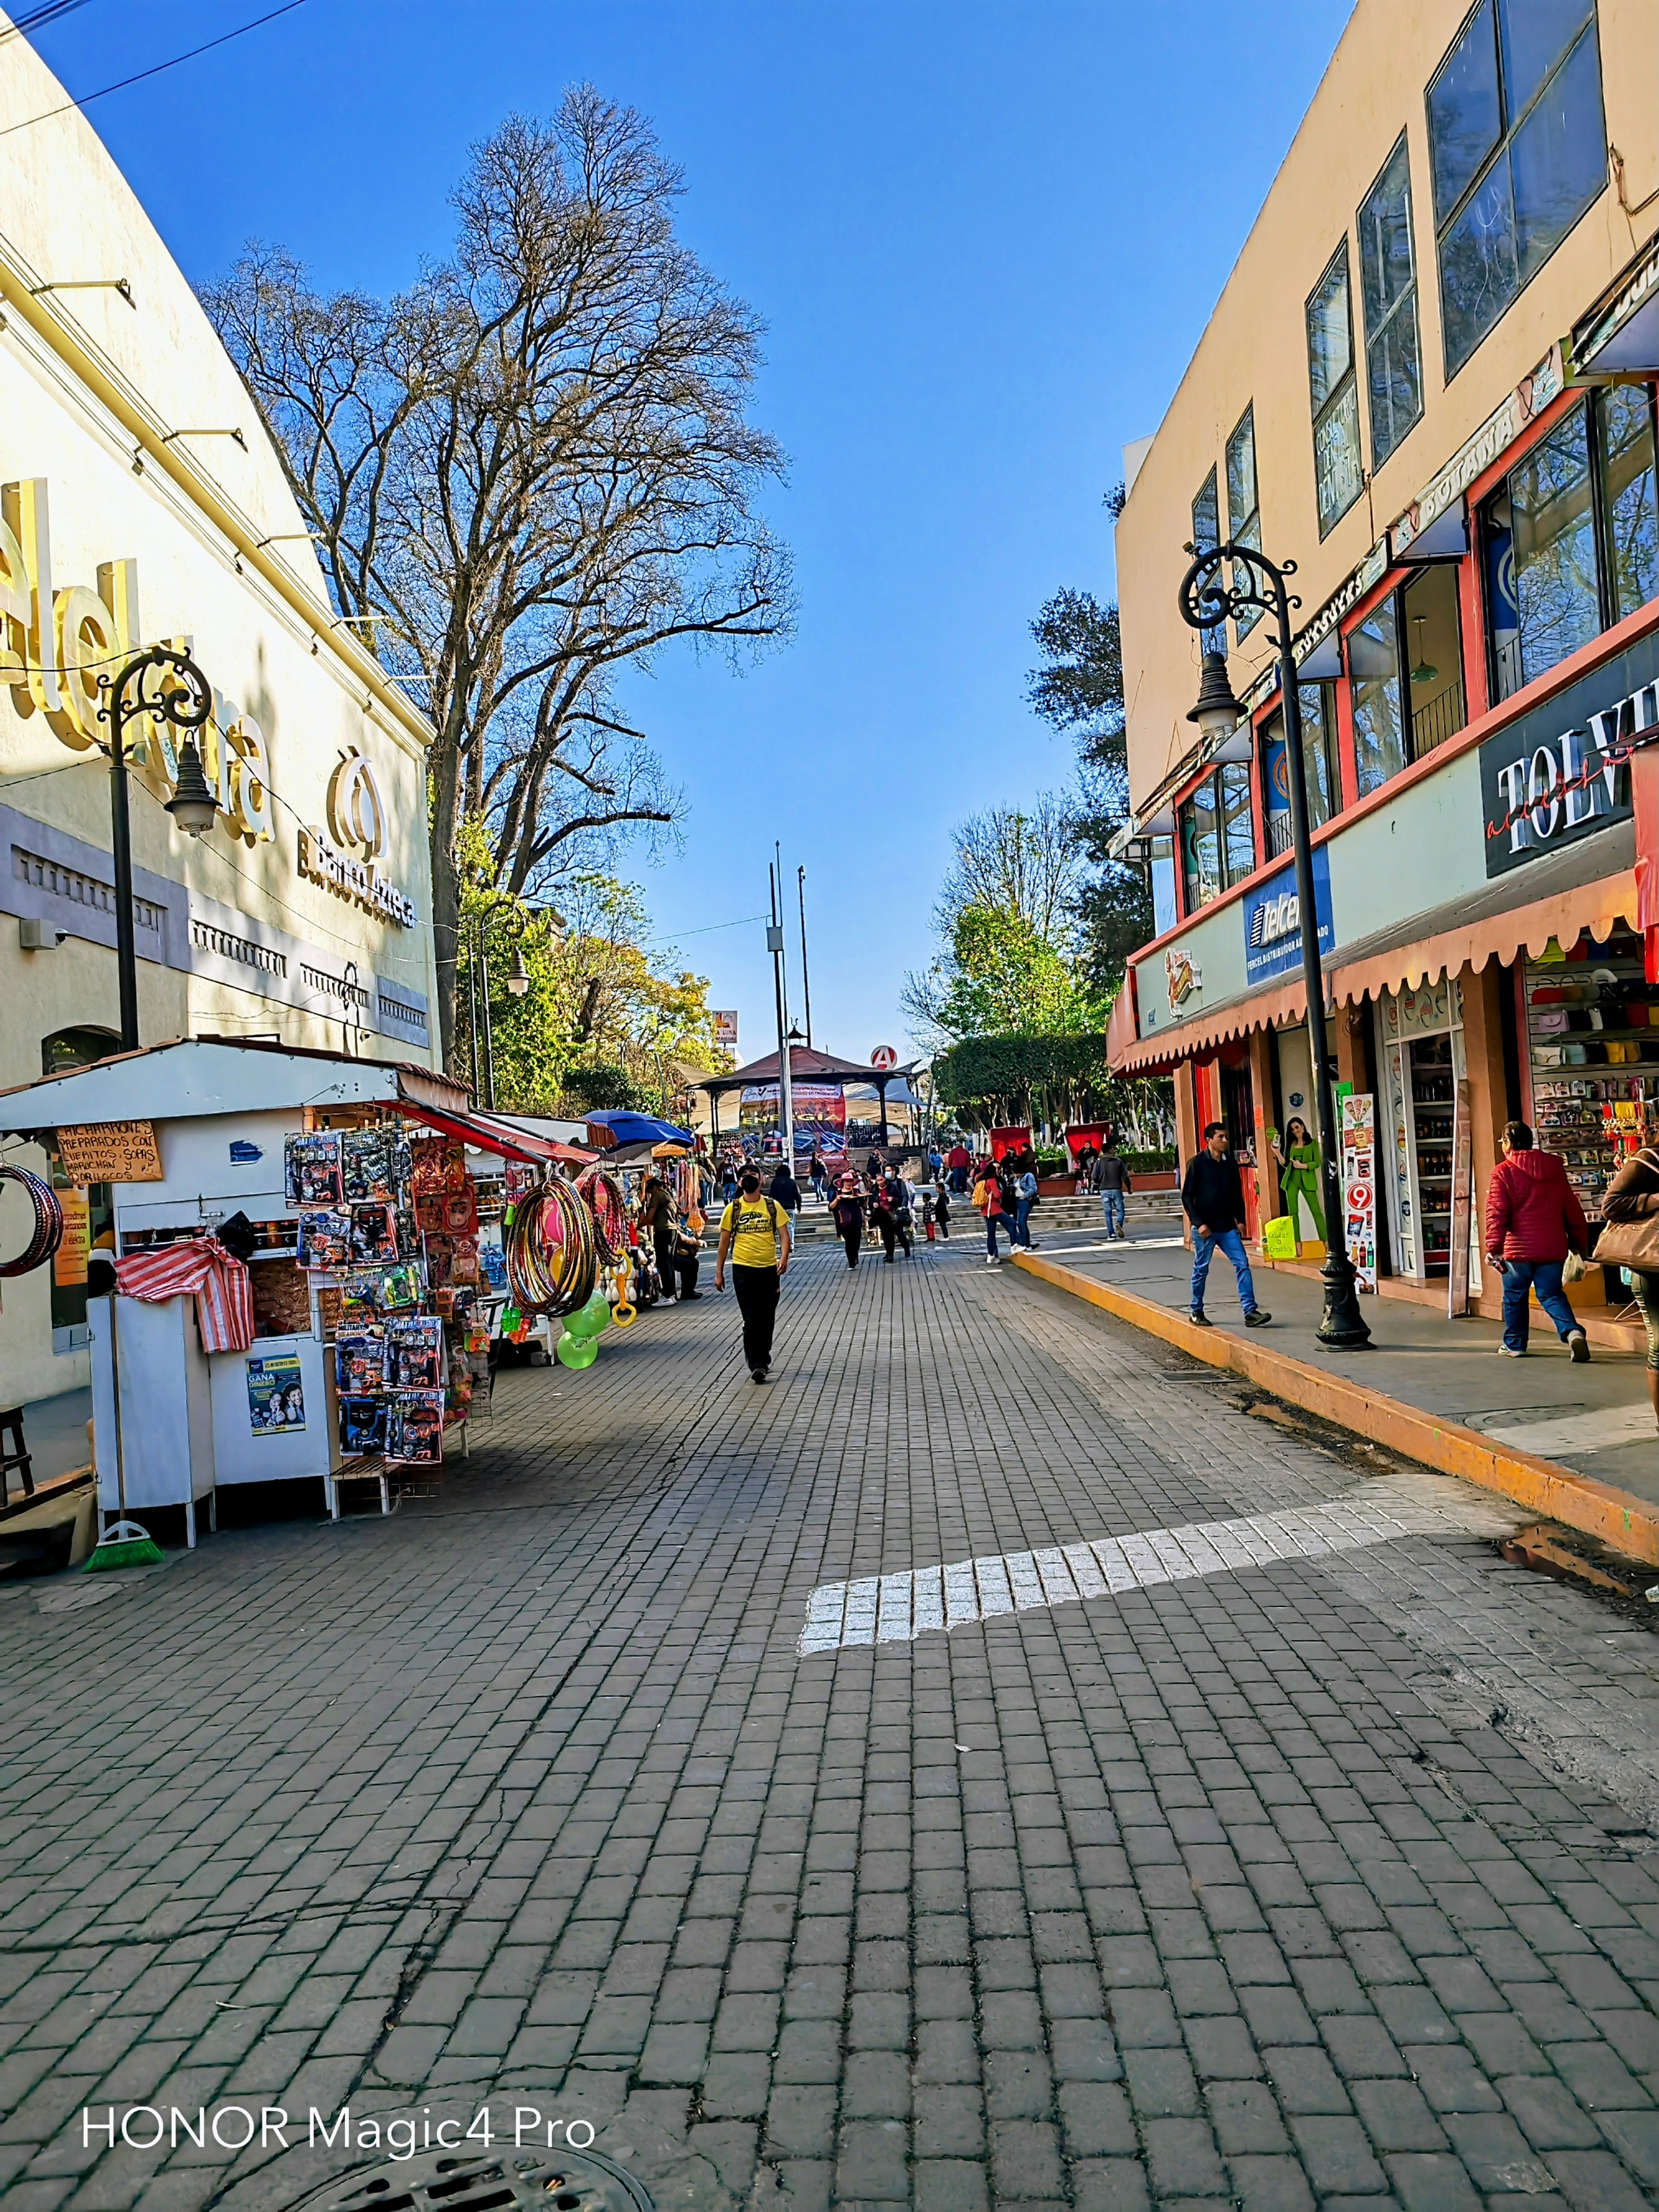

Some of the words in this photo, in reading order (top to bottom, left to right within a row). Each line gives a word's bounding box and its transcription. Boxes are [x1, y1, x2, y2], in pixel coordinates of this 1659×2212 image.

[1424, 409, 1514, 520] BOTANA
[311, 825, 368, 898] Banco
[370, 865, 415, 928] Azteca
[1247, 956, 1264, 970] FERCEL
[1263, 942, 1296, 964] DISTRIBUIDOR
[57, 1122, 152, 1137] CHICHARRONES
[59, 1136, 130, 1151] PREPARADOS
[132, 1135, 153, 1147] CON
[123, 1148, 155, 1162] SOPAS
[66, 1159, 117, 1172] MARUCHAN
[1353, 1186, 1367, 1208] 9
[248, 1373, 275, 1382] GANA
[249, 1380, 275, 1388] DINERO
